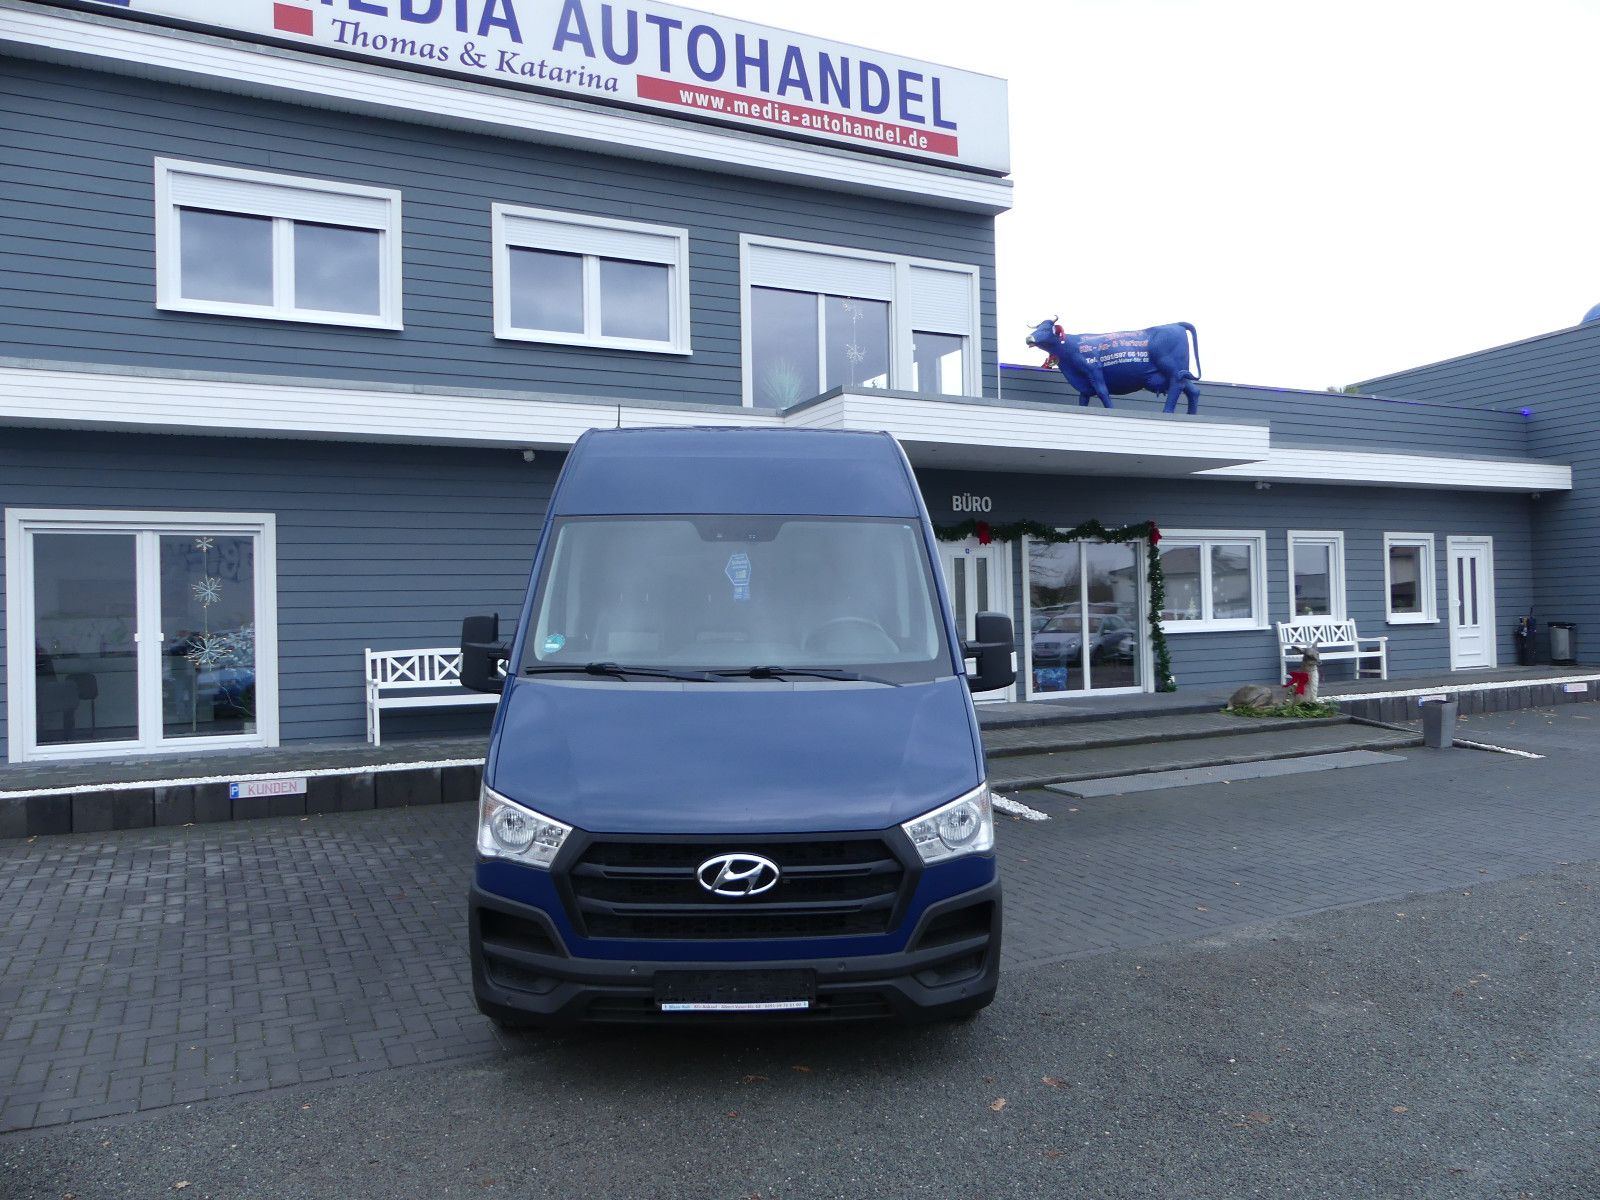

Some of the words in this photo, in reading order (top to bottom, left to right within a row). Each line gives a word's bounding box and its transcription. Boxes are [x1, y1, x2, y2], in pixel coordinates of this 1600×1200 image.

[331, 18, 449, 62] Thomas
[459, 41, 487, 69] &
[495, 49, 619, 93] Katarina
[552, 0, 958, 131] AUTOHANDEL
[679, 89, 928, 149] www.media-autohandel.de
[952, 492, 992, 512] BÜRO
[231, 785, 239, 796] P
[248, 781, 297, 796] KUNDEN
